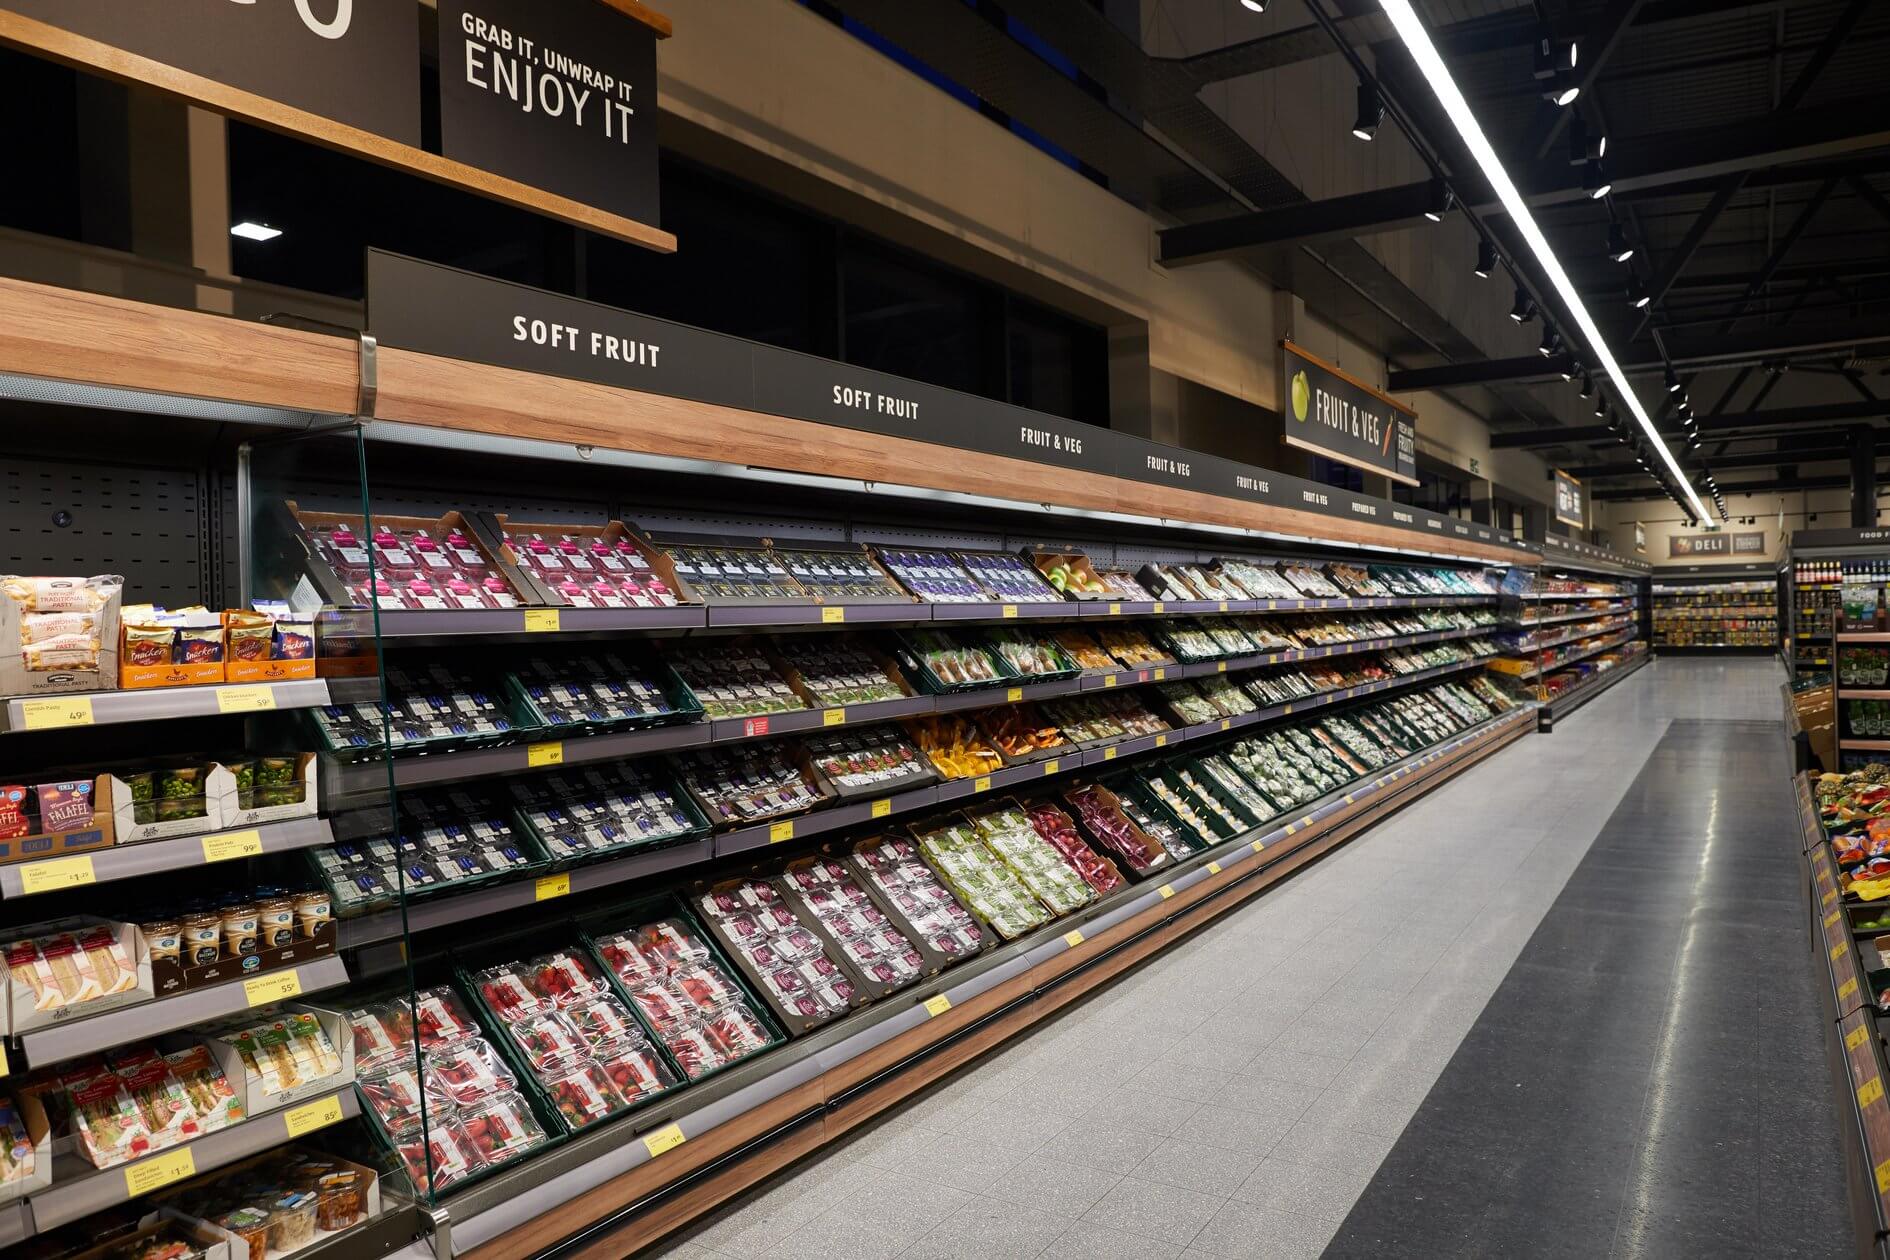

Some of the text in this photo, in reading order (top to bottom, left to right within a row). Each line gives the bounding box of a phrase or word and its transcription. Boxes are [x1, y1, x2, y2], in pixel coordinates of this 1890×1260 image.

[461, 12, 633, 102] GRAB IT, UNWRAP IT
[465, 39, 634, 145] ENJOY IT
[514, 316, 659, 367] SOFT FRUIT
[834, 386, 918, 419] SOFT FRUIT
[1315, 389, 1380, 446] FRUIT & VEG
[1022, 428, 1081, 454] FRUIT & VEG
[1148, 456, 1189, 476] FRUIT & VEG
[1237, 476, 1268, 492] FRUIT & VEG
[1304, 491, 1315, 502] FRUIT
[1695, 539, 1722, 551] DELI
[47, 803, 89, 824] FALAFEL
